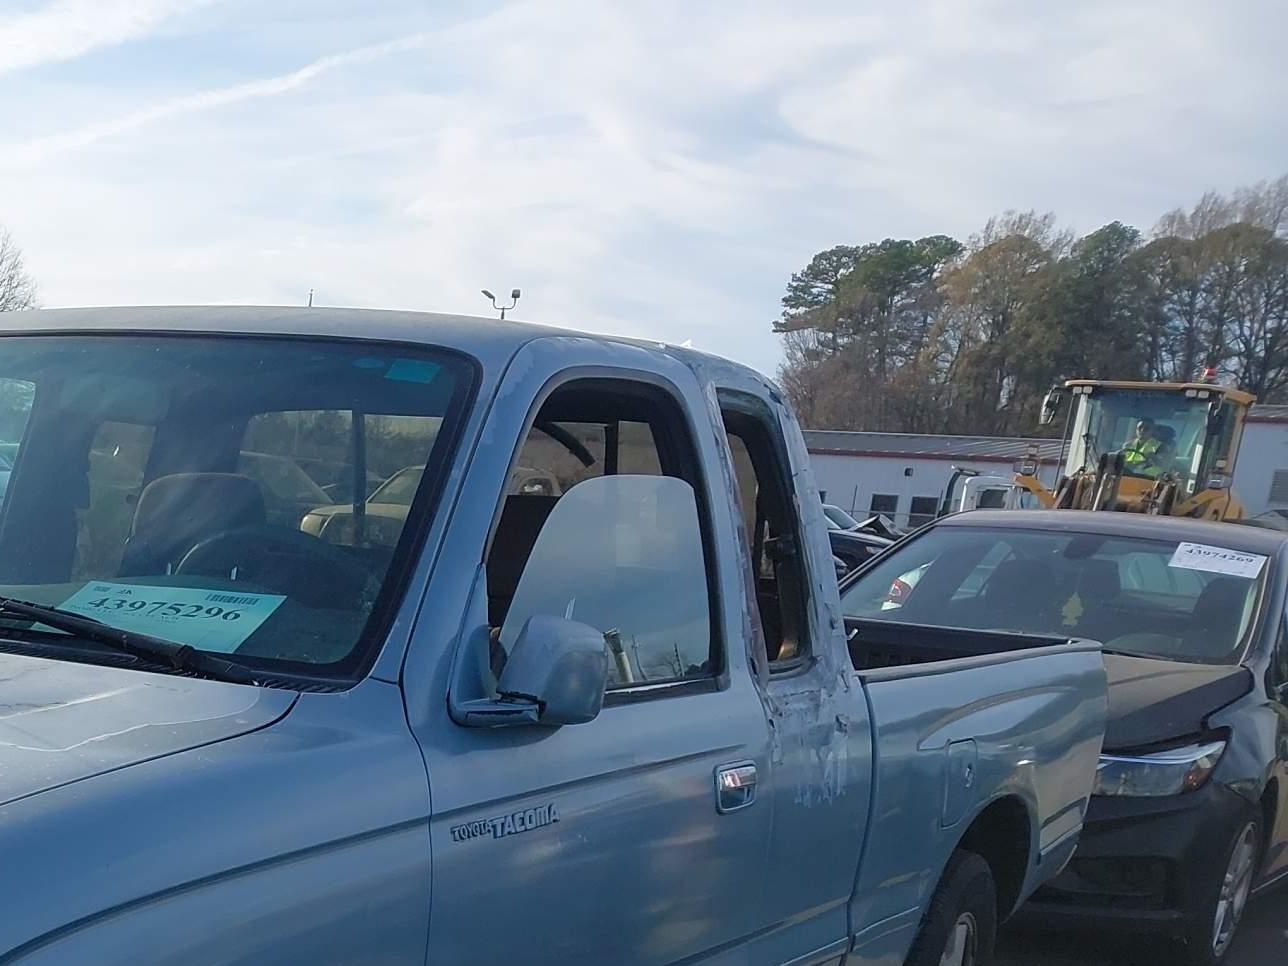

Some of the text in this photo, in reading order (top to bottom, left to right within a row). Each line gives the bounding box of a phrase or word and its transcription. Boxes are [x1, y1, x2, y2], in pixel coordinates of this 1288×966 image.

[87, 597, 242, 621] 43975296
[450, 803, 560, 841] TOYOTA TACOMA
